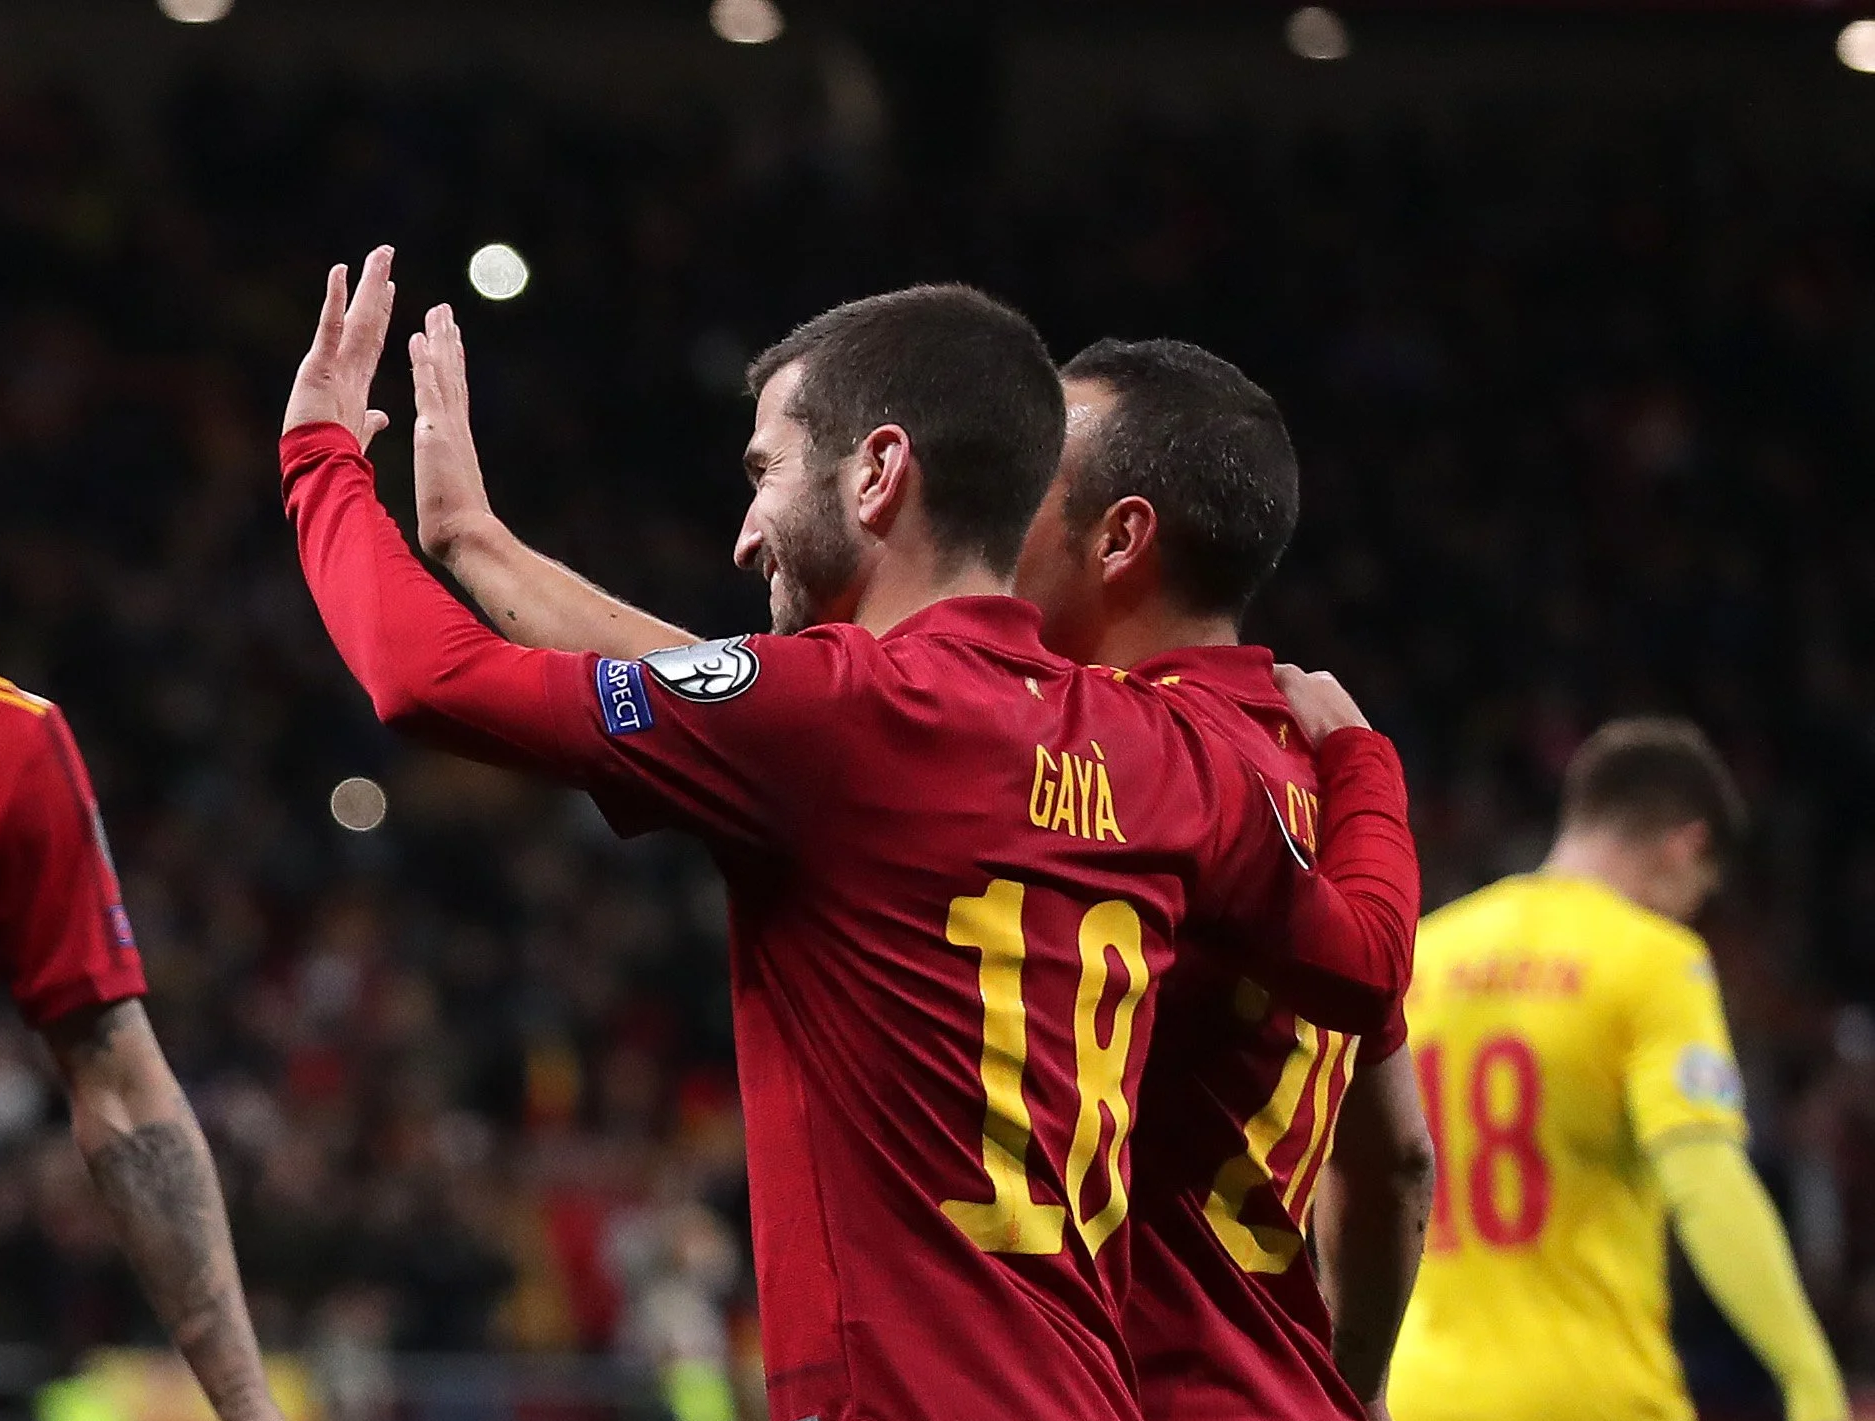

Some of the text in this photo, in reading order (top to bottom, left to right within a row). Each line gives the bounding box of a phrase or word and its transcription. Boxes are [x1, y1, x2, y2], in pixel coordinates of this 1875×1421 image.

[608, 660, 641, 728] SPECT
[1029, 740, 1127, 843] GAYÀ
[940, 878, 1150, 1258] 18
[1414, 1036, 1553, 1256] 18
